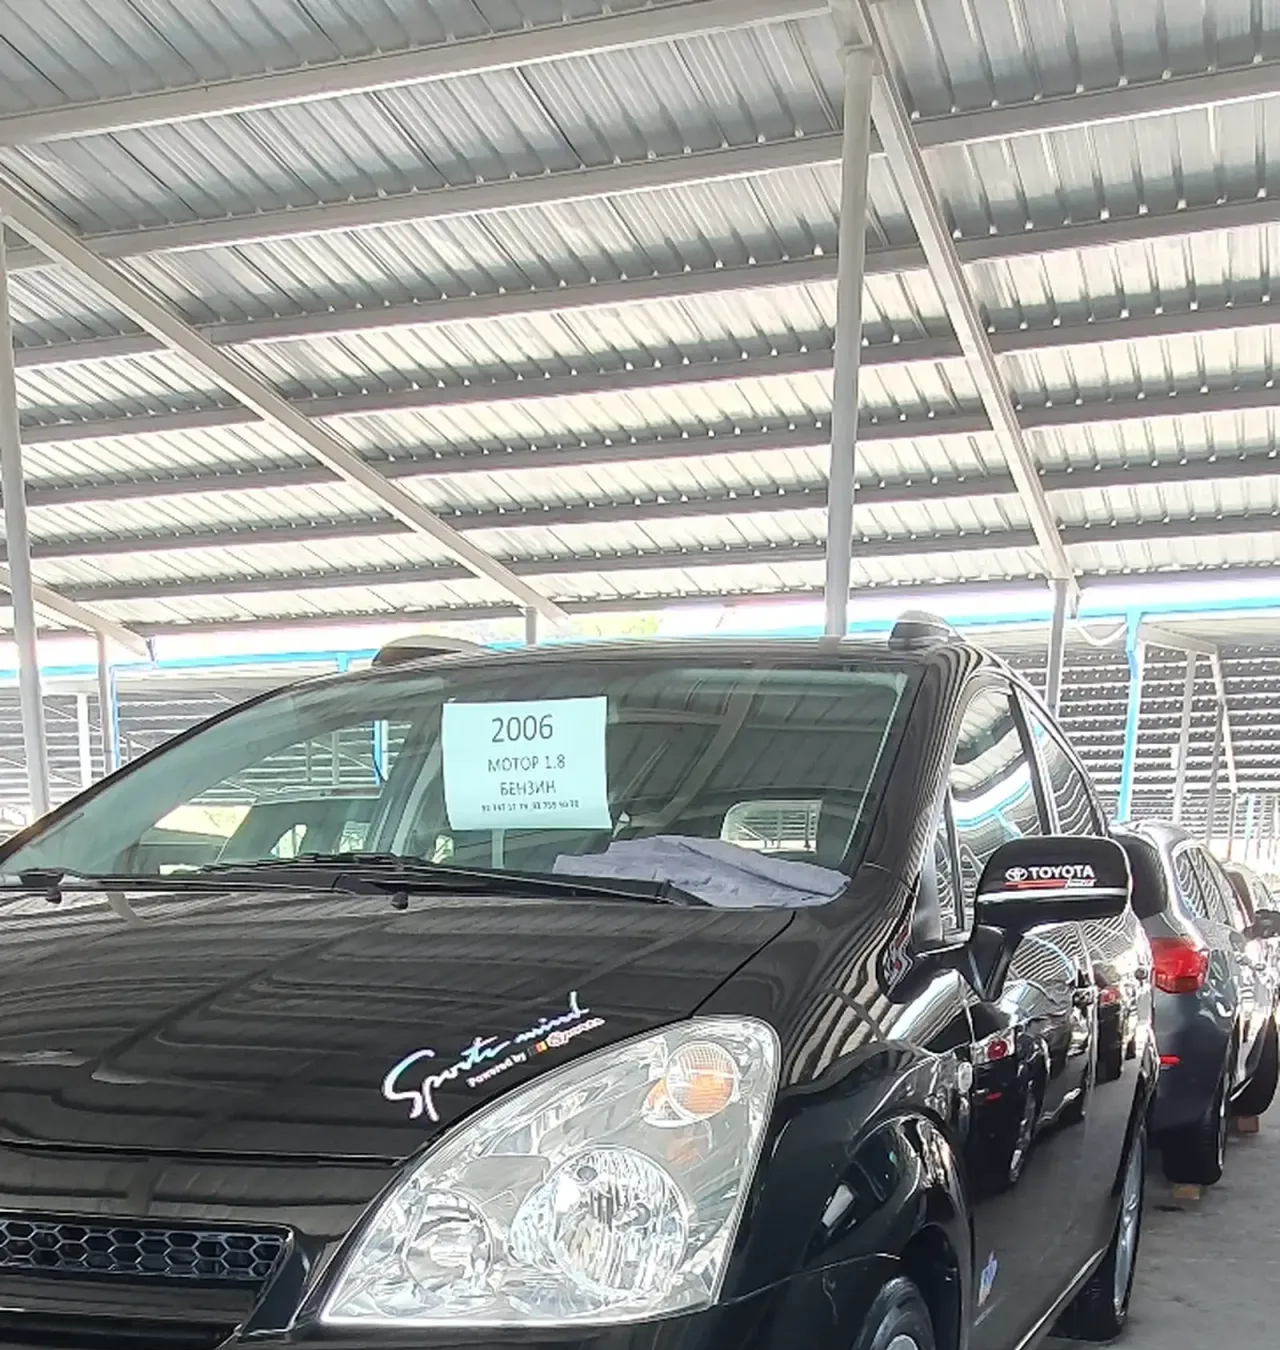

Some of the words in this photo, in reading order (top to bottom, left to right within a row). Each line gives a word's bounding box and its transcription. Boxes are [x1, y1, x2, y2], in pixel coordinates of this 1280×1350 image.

[491, 714, 553, 743] 2006
[487, 755, 539, 772] МОТОР
[545, 754, 566, 770] 1.8
[500, 780, 556, 796] БЕНЗИН
[1028, 865, 1095, 879] TOYOTA
[465, 1056, 514, 1088] Powered
